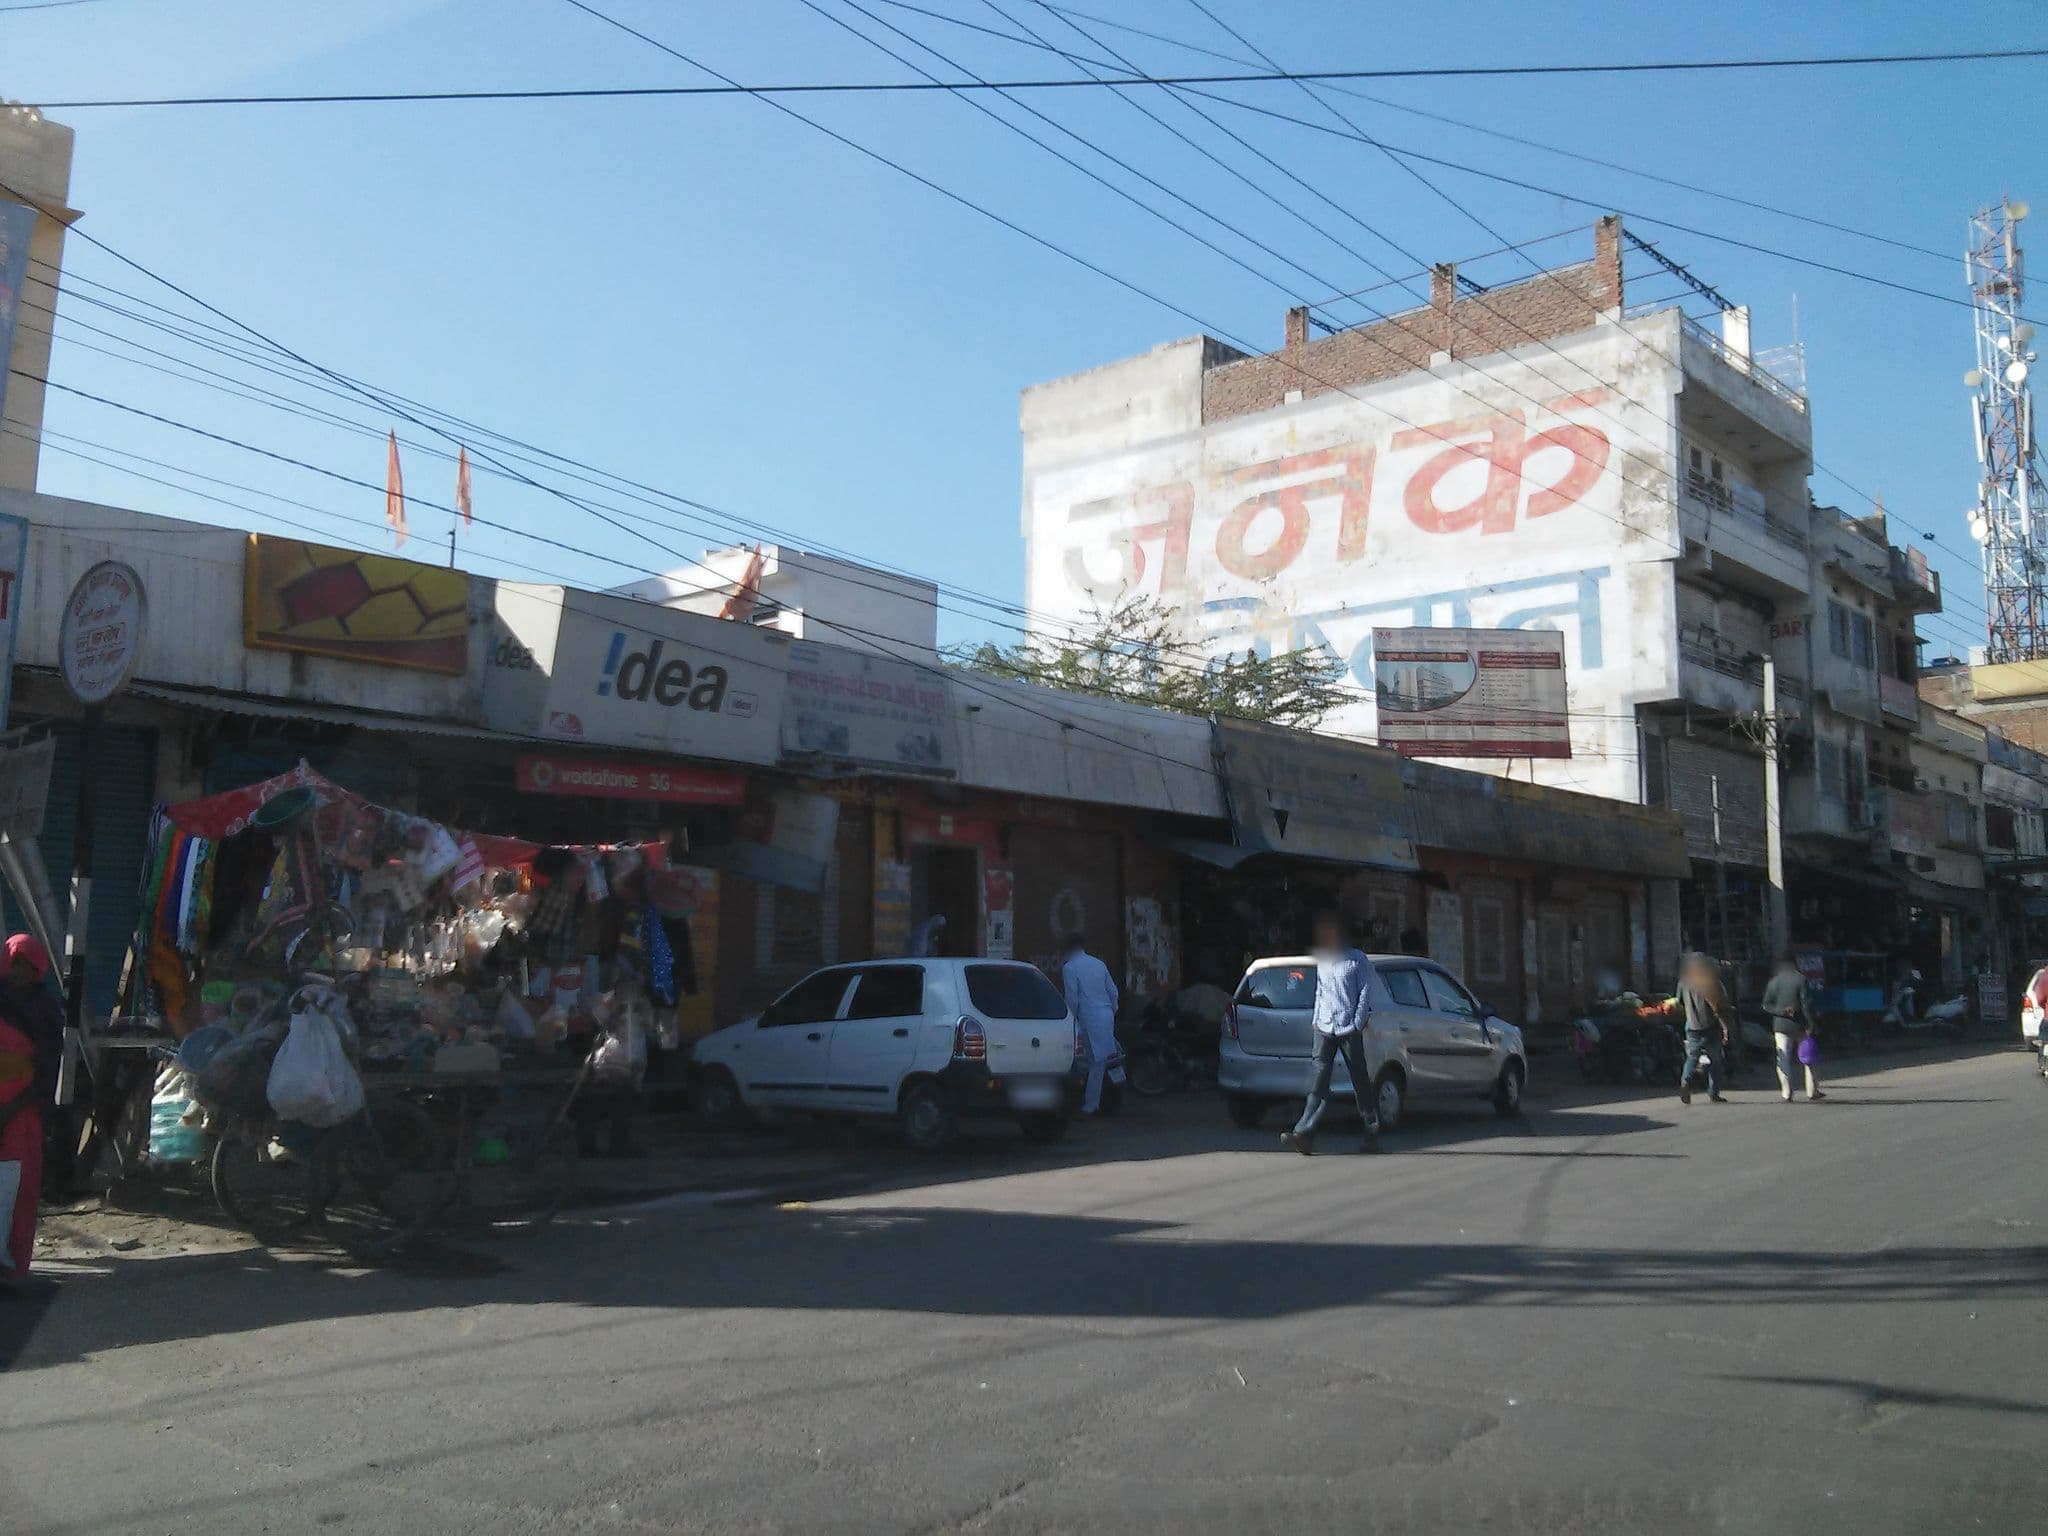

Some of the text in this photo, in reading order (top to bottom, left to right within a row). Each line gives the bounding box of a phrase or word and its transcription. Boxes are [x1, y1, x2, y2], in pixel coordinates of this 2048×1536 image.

[1062, 383, 1611, 597] जनक
[560, 768, 639, 789] vodafone
[648, 773, 671, 792] 3G
